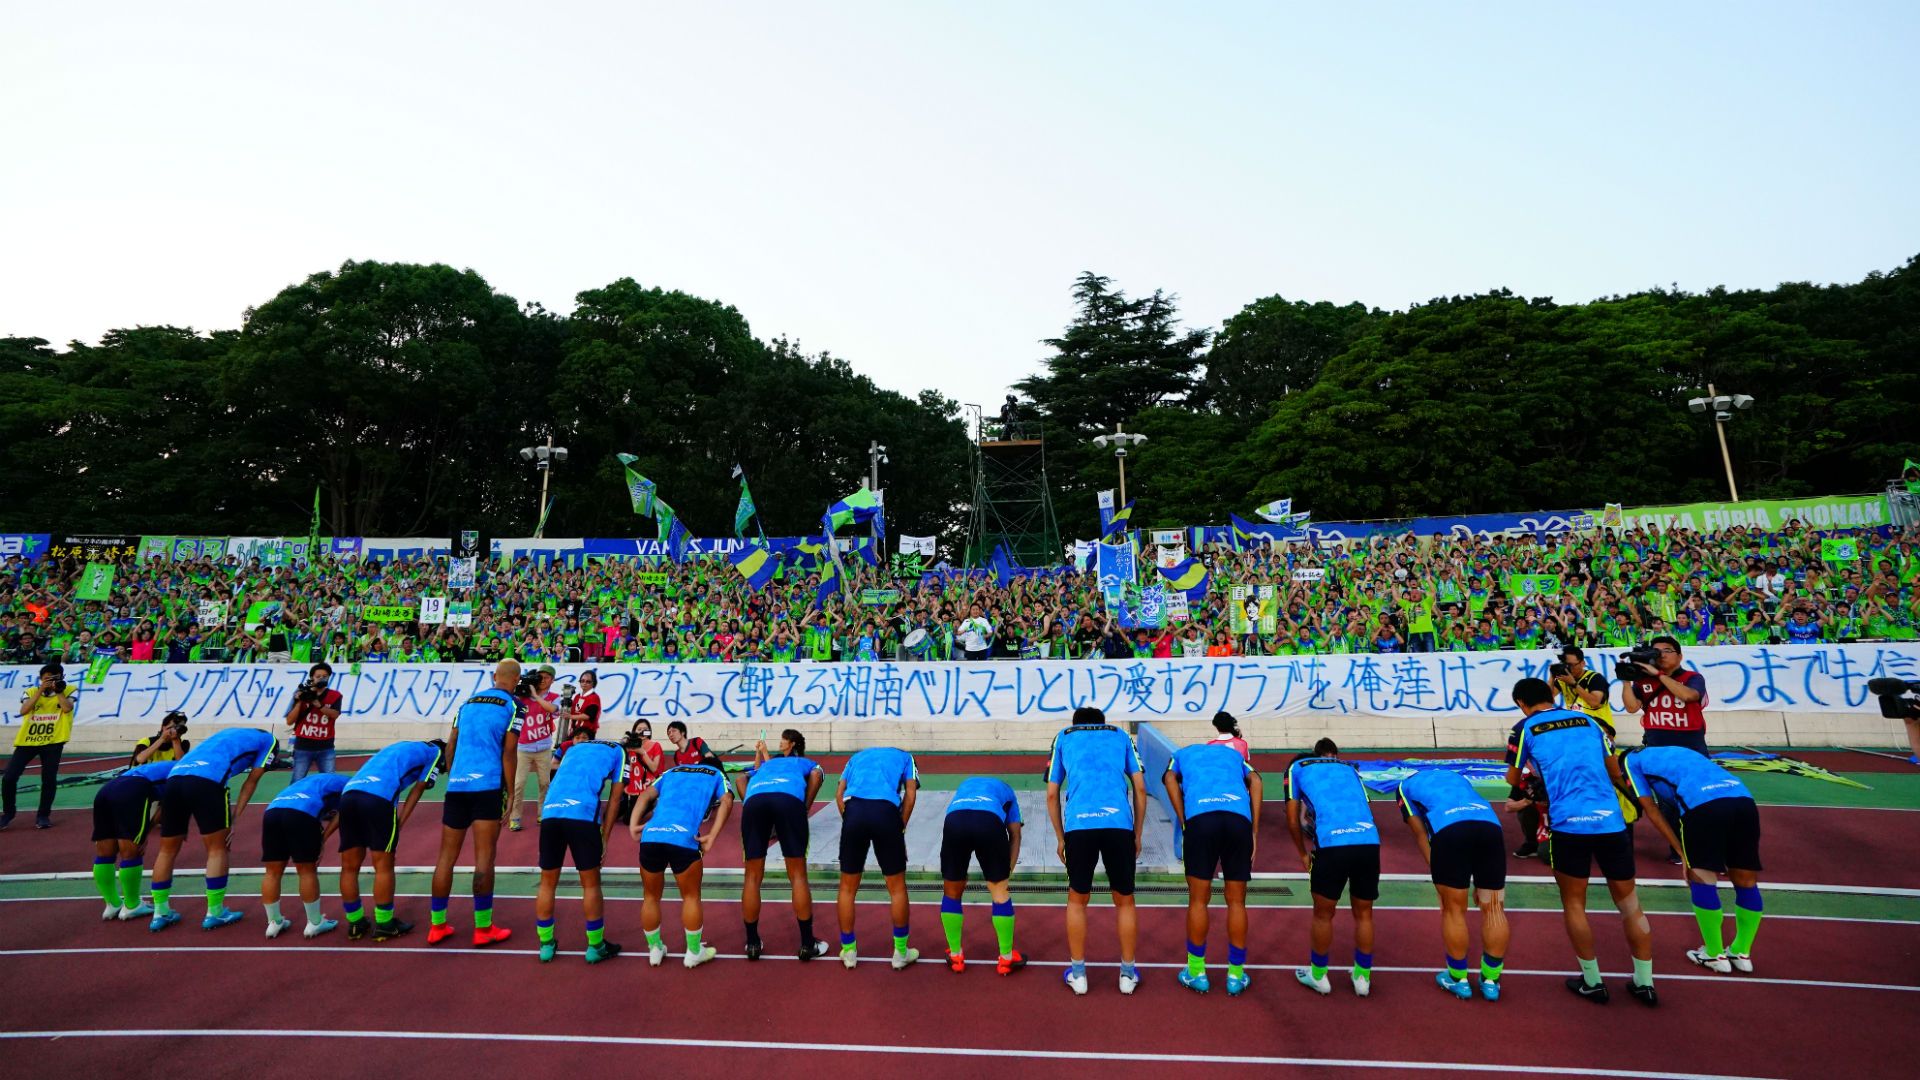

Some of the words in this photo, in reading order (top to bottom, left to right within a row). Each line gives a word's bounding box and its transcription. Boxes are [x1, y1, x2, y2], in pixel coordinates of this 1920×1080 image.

[1779, 501, 1882, 526] SHONAN
[635, 540, 702, 554] VAS
[426, 599, 439, 612] 19
[1555, 718, 1587, 728] RIZAP
[1649, 711, 1689, 727] NRH
[28, 722, 55, 735] 006
[300, 724, 328, 738] NRH
